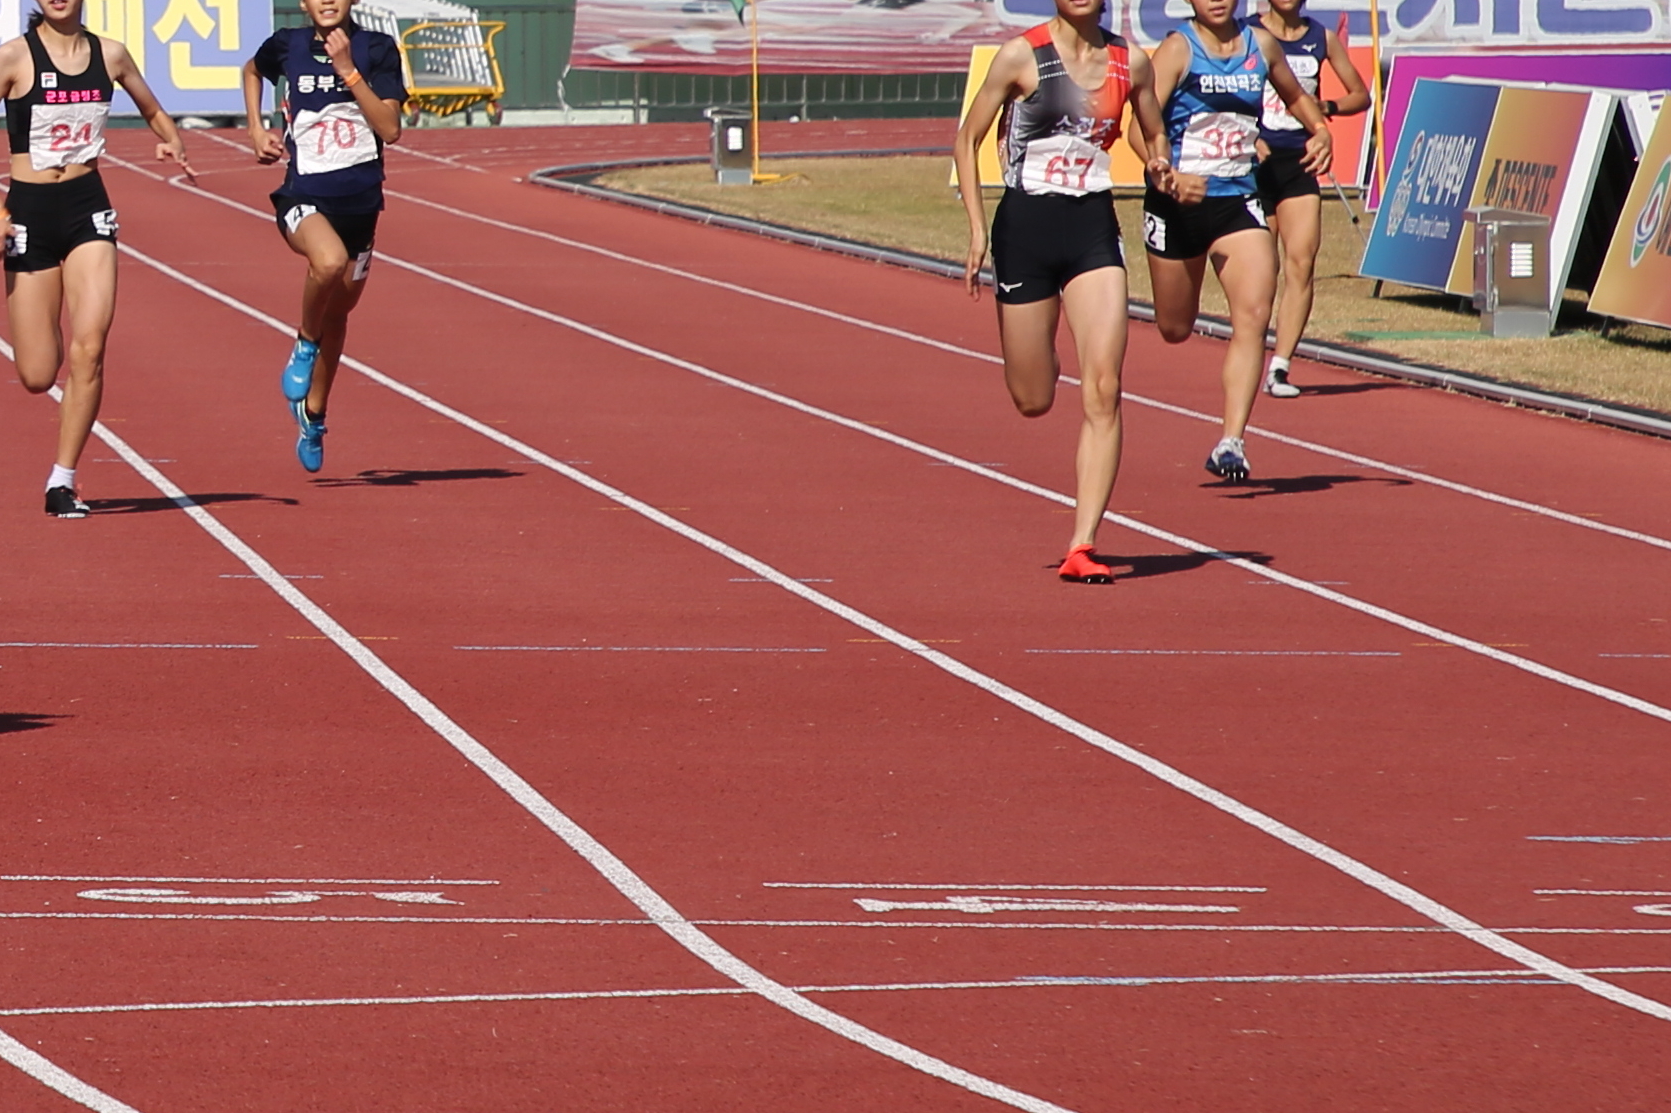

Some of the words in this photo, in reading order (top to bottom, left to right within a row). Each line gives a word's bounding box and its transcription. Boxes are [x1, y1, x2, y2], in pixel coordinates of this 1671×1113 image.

[1200, 74, 1261, 93] 연천전곡초
[309, 118, 356, 155] 70
[1201, 128, 1247, 160] 36
[1044, 156, 1094, 188] 67
[1146, 215, 1158, 246] 2
